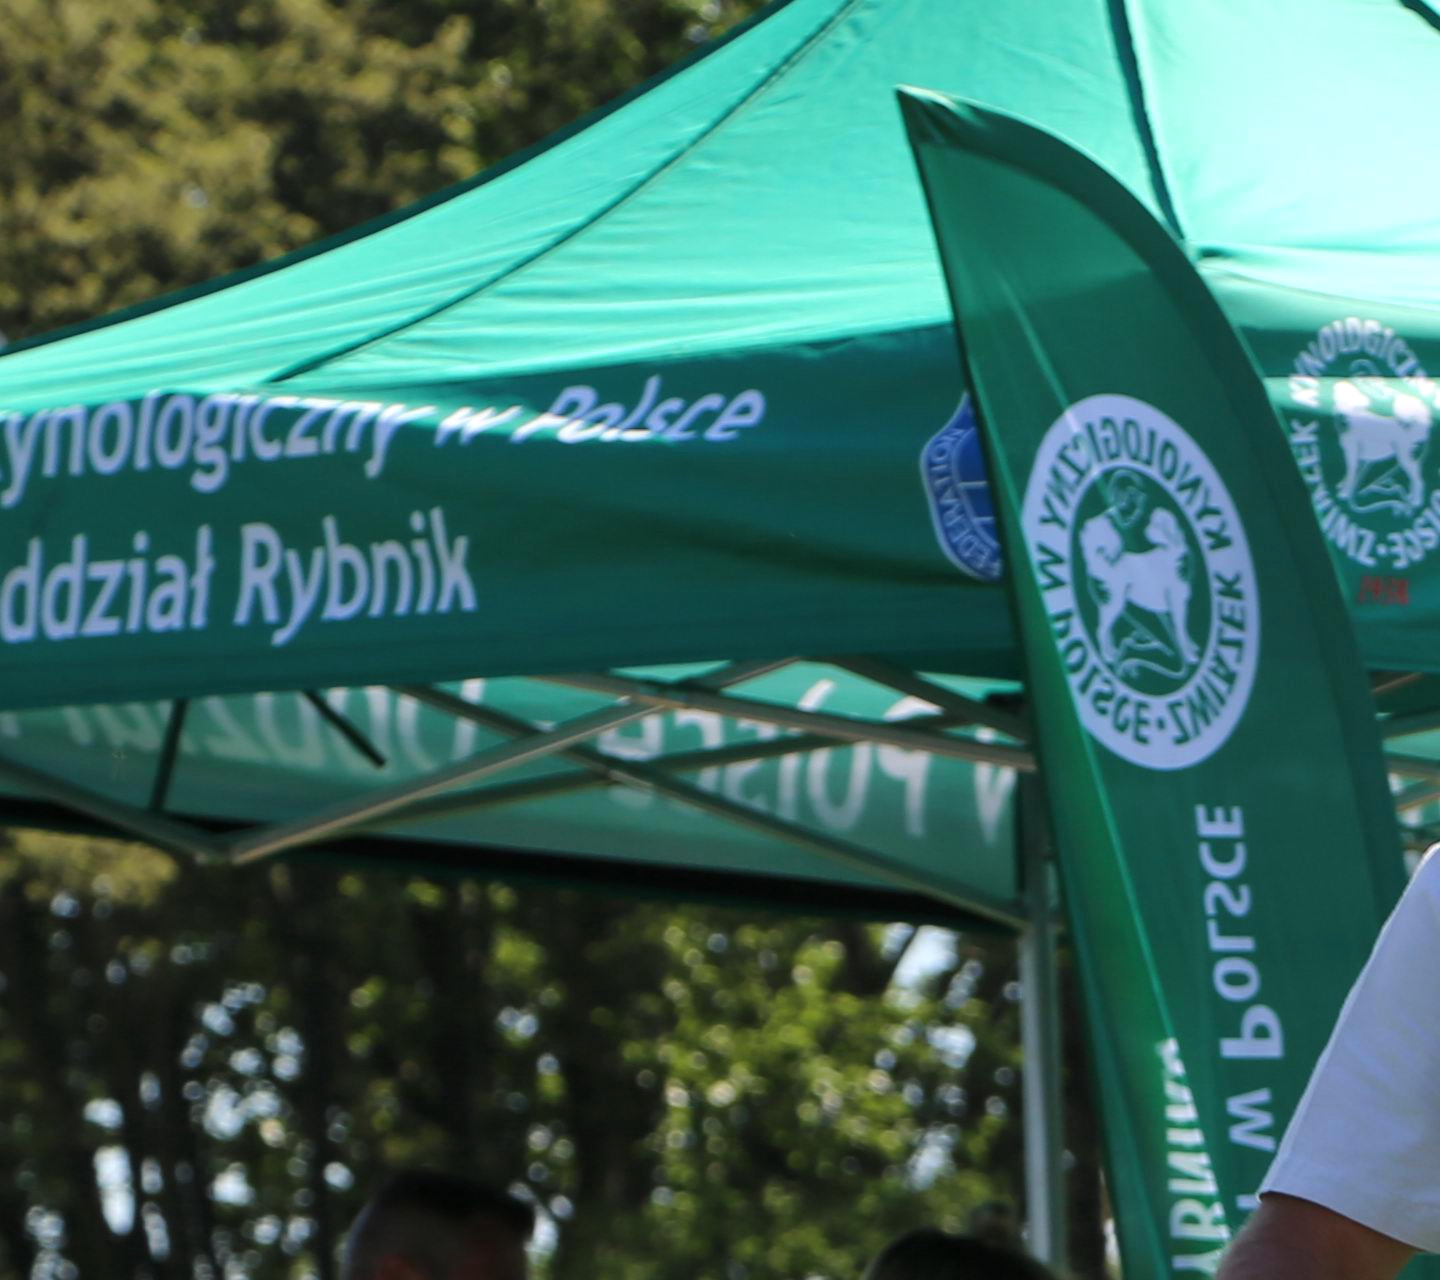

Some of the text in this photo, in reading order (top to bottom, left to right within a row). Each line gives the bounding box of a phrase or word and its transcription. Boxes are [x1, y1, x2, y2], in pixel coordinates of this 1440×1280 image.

[0, 376, 764, 507] ynologiczny w Polsce
[0, 506, 478, 647] ddział Rybnik
